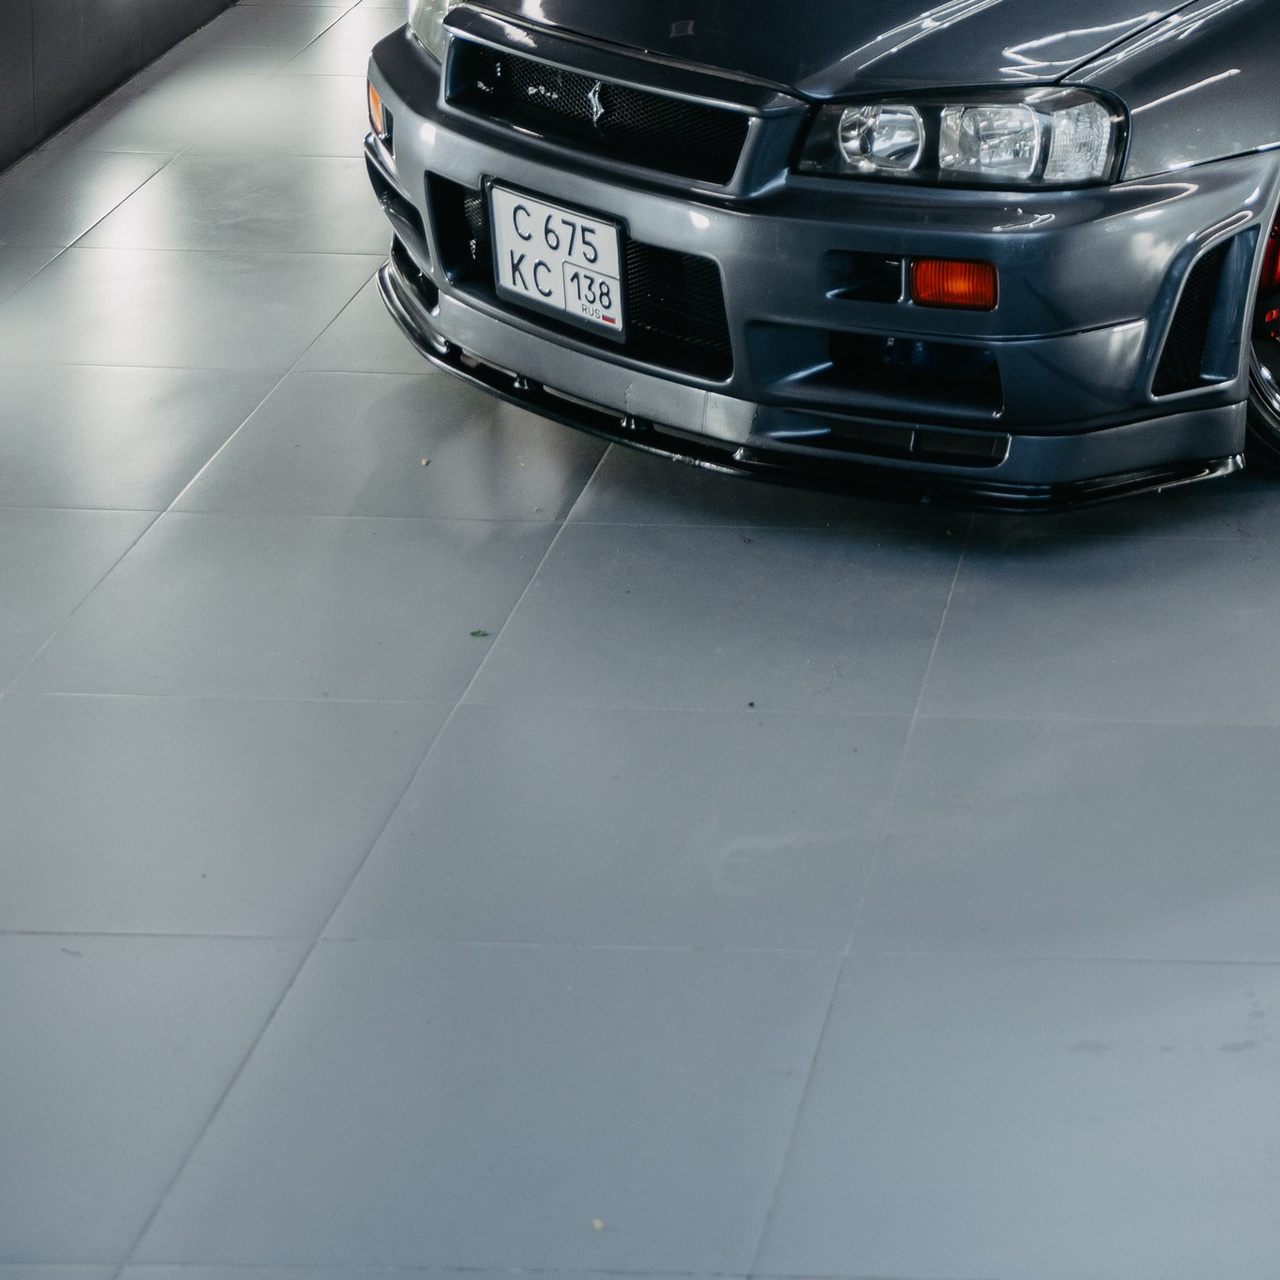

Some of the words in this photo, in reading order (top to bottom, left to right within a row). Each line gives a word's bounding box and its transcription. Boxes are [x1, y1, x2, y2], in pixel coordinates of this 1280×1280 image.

[544, 213, 599, 264] 675
[570, 271, 612, 311] 138
[581, 303, 601, 320] RUS
